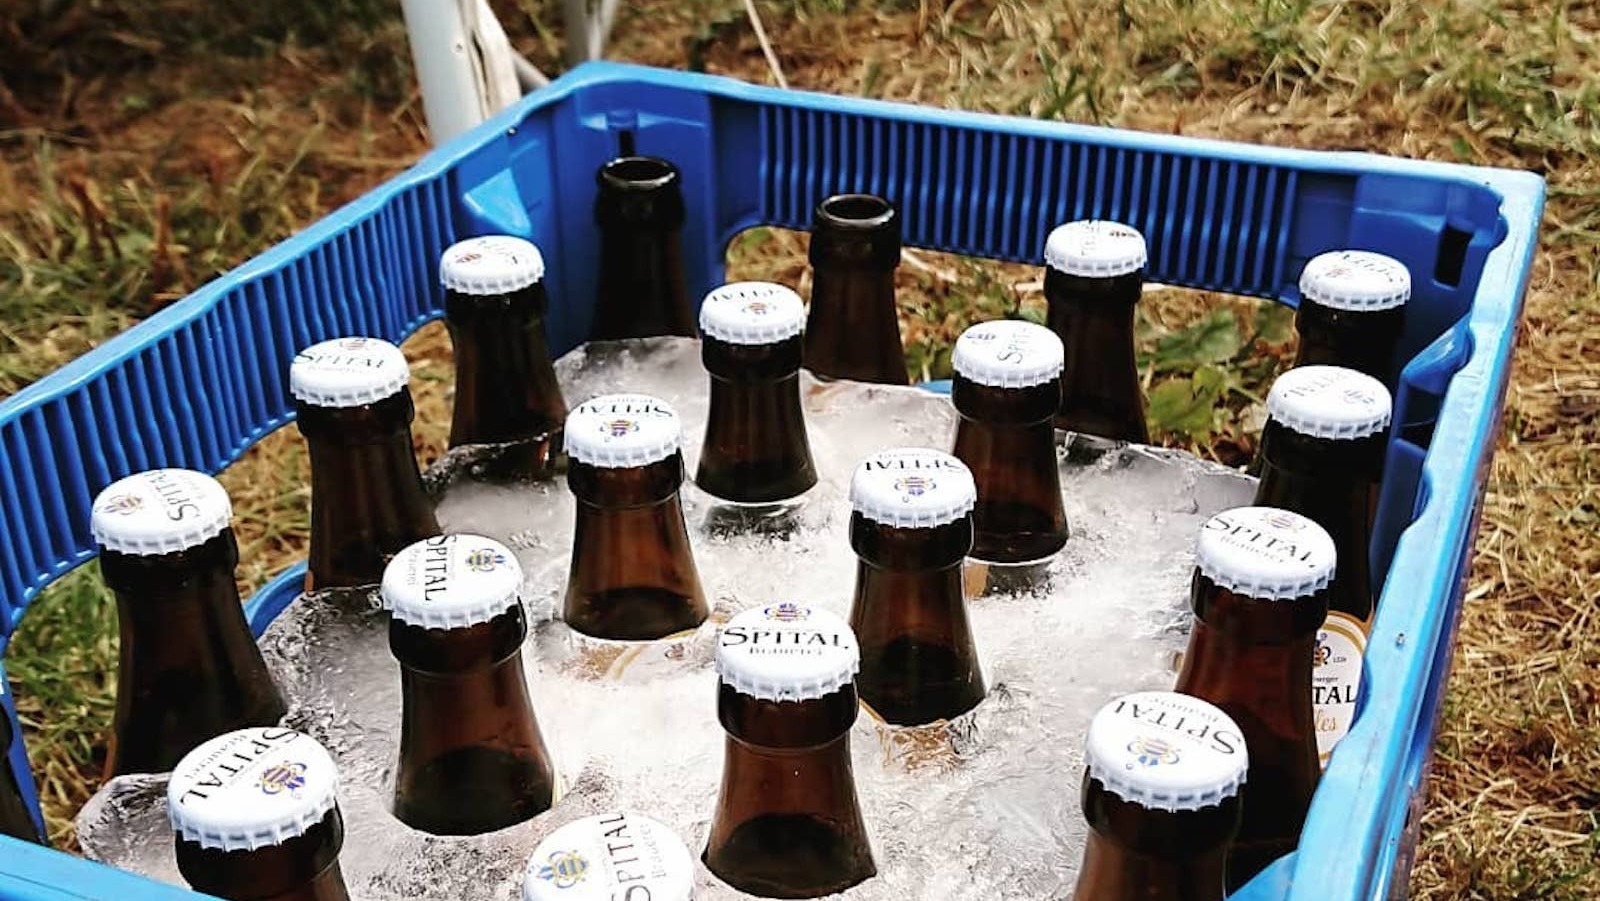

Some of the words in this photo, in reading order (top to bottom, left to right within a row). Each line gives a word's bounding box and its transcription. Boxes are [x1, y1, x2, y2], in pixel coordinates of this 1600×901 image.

[1203, 516, 1316, 569] SPITAL
[721, 625, 850, 649] SPITAL
[1113, 700, 1243, 756] SPITAL
[178, 729, 301, 806] SPITAL
